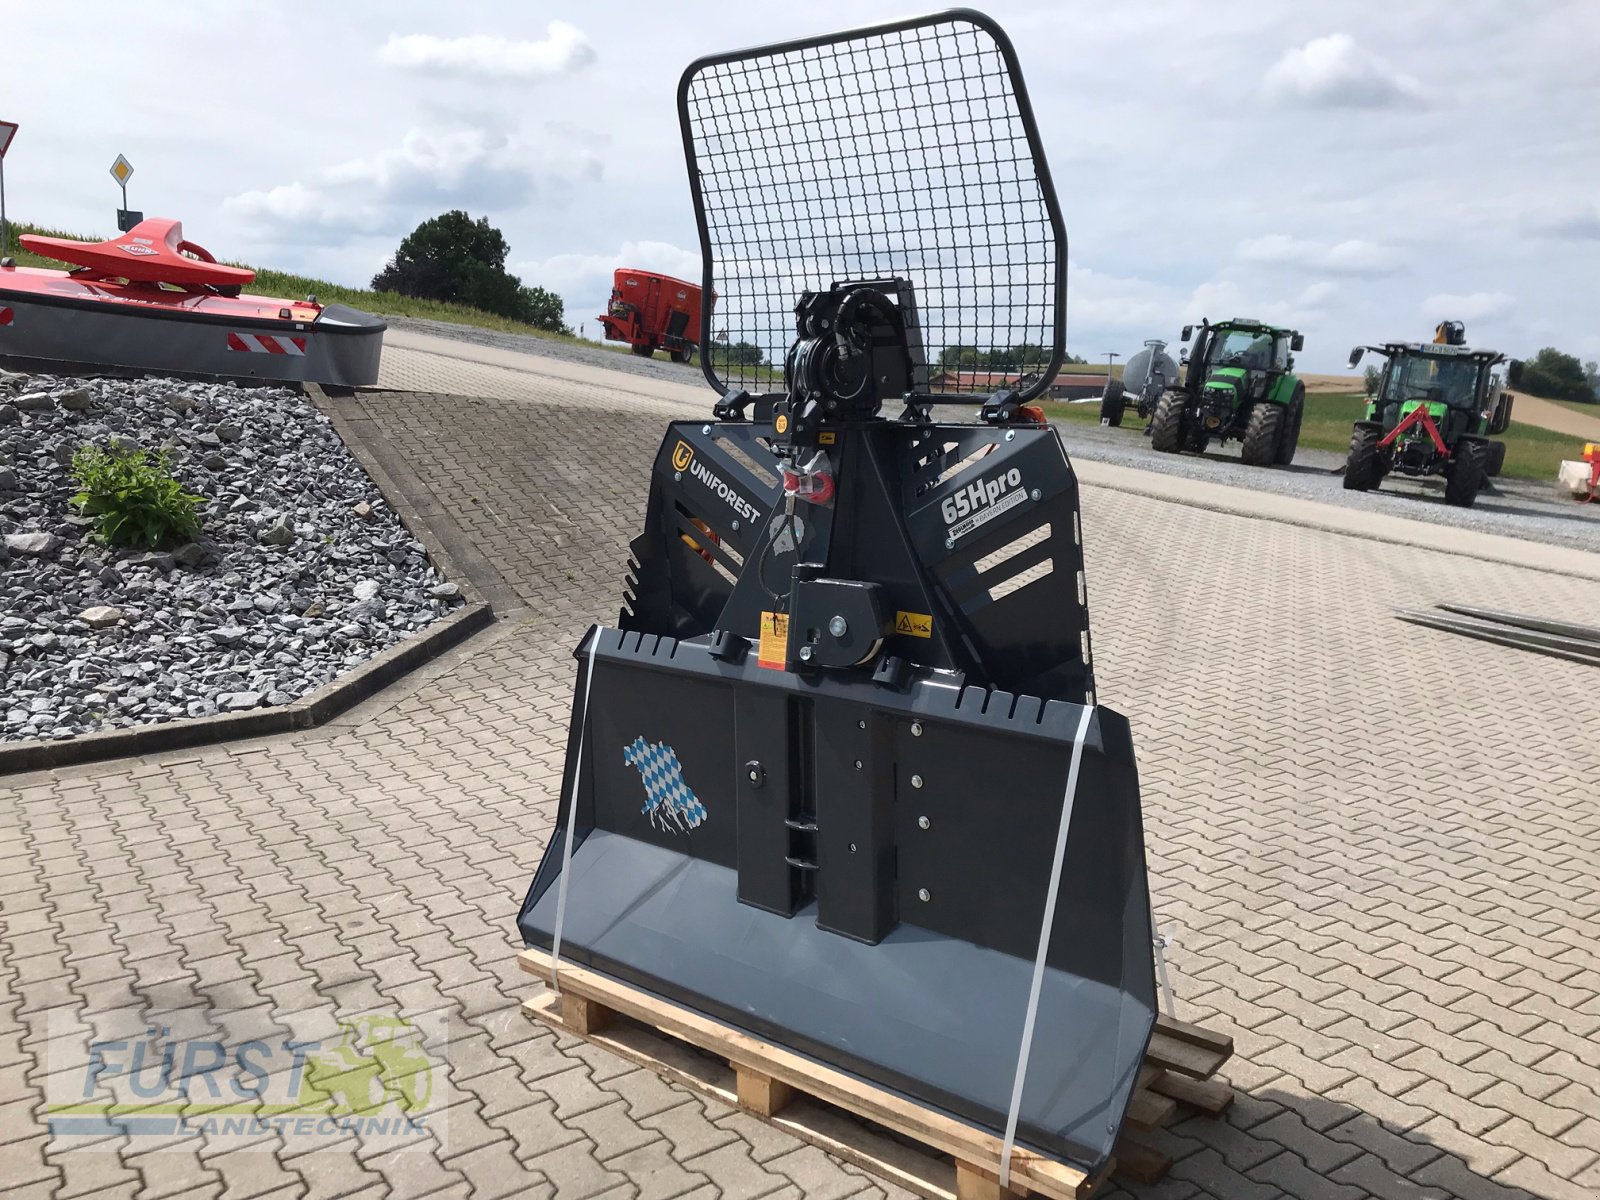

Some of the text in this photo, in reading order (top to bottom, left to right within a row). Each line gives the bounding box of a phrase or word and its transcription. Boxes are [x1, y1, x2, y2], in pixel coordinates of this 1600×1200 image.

[690, 459, 761, 524] UNIFOREST
[941, 467, 1021, 524] 65Hpro
[1001, 492, 1024, 509] EDITION
